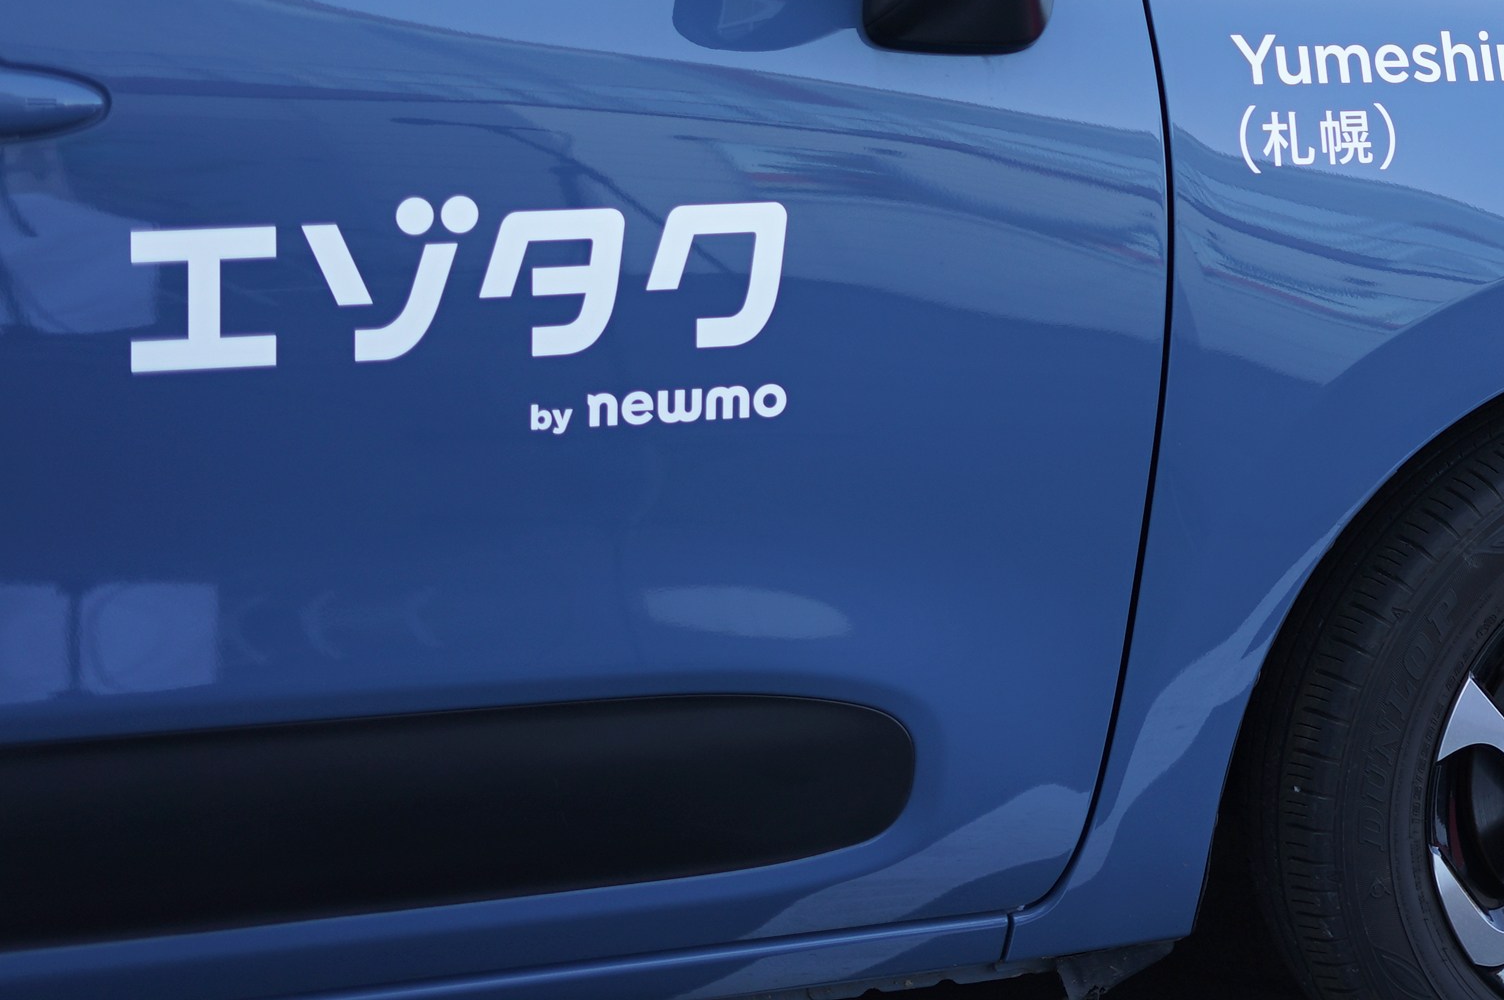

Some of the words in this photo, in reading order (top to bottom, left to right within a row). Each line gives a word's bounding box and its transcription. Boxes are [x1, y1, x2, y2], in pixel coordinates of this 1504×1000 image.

[1239, 103, 1396, 174] (札幌)
[130, 195, 788, 374] エゾタク
[530, 404, 573, 434] by
[587, 383, 788, 428] newmo
[1359, 590, 1459, 852] DUNLOP
